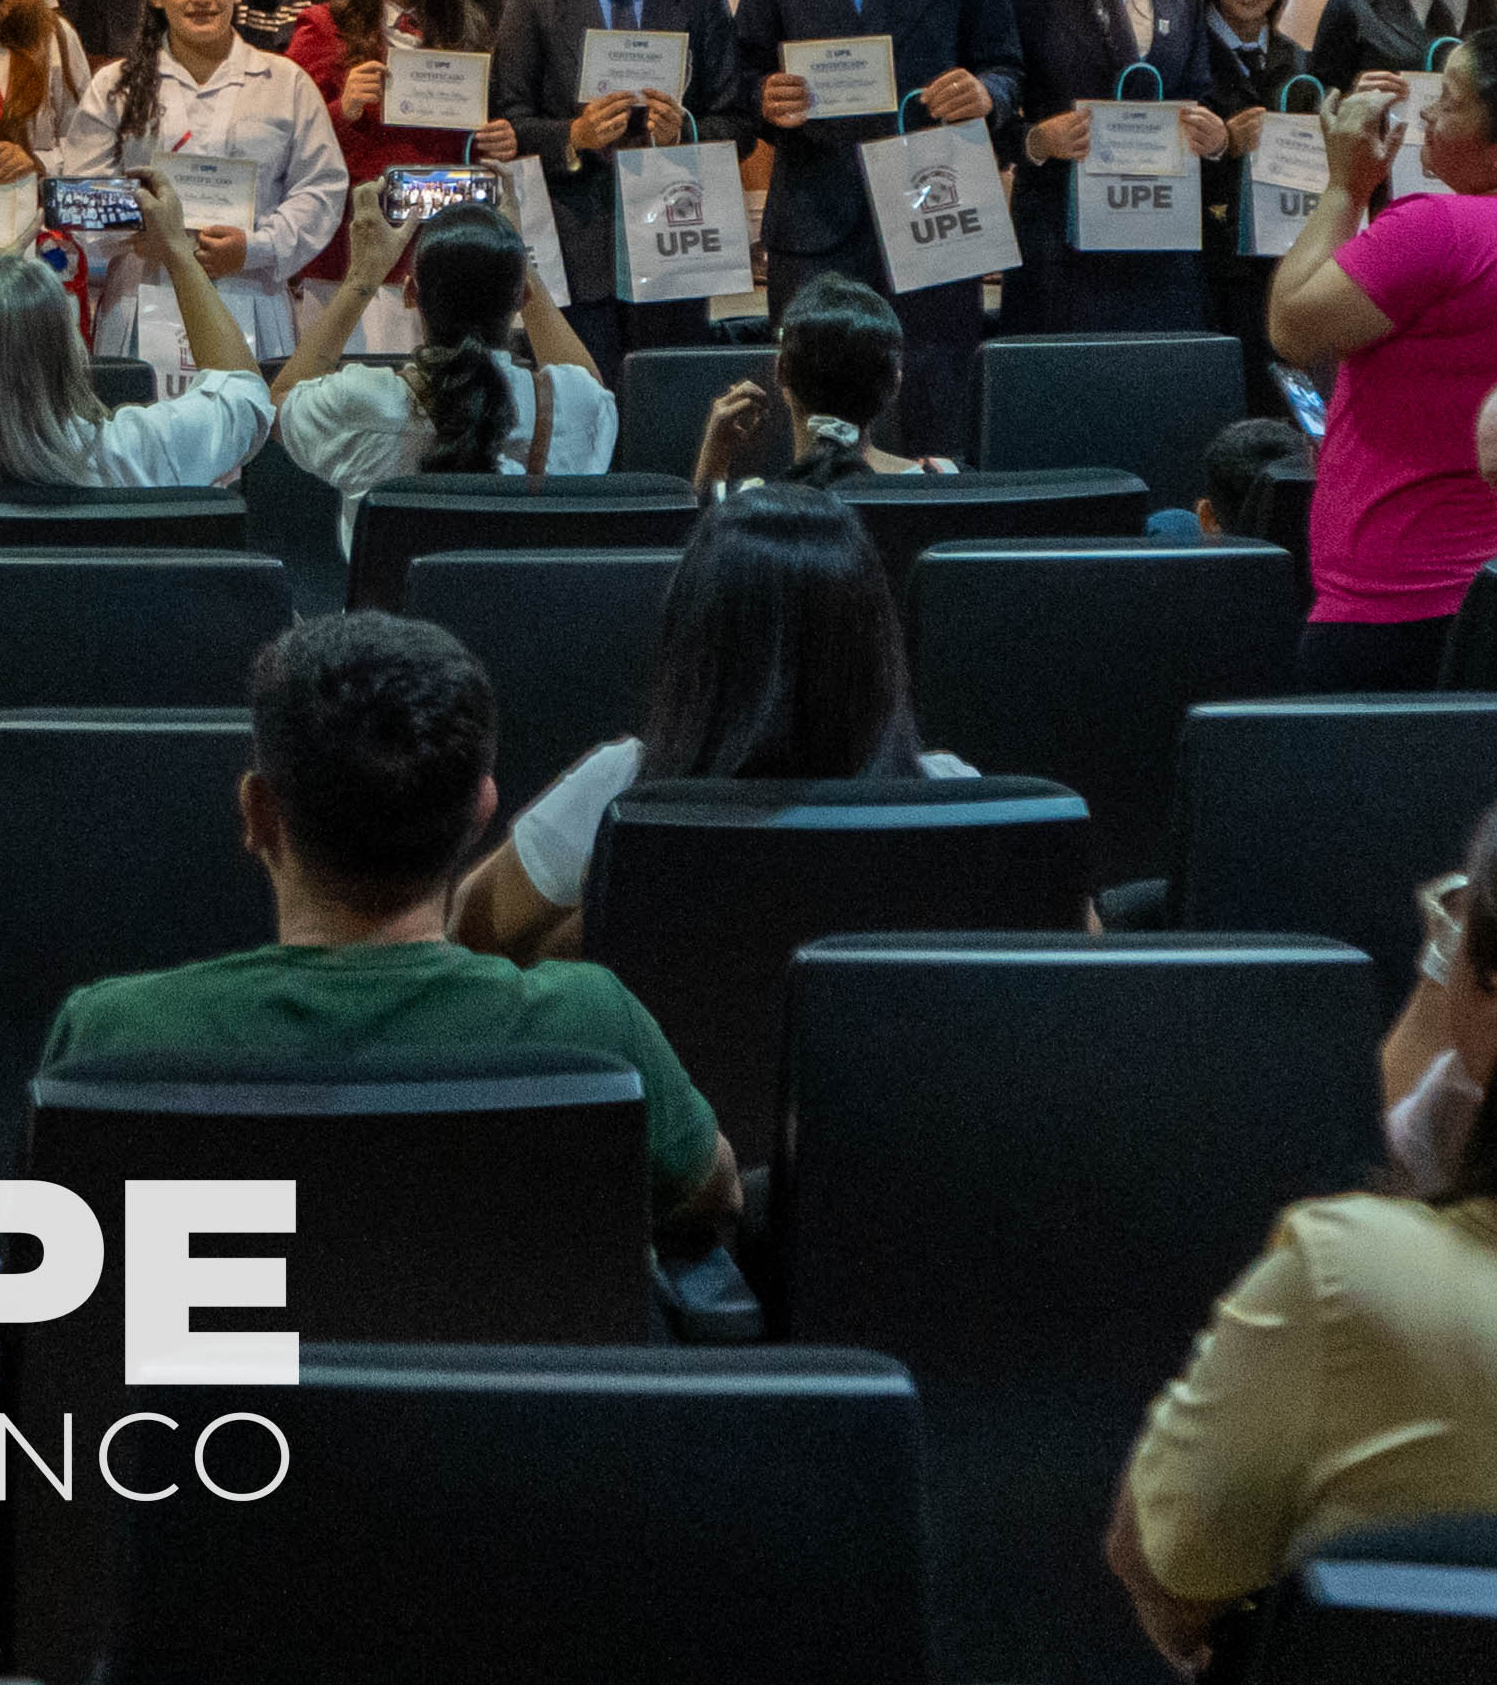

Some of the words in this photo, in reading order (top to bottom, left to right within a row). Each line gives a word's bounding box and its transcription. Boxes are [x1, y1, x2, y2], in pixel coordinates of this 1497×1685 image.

[1107, 186, 1172, 209] UPE
[1280, 193, 1320, 217] UP
[911, 209, 982, 245] UPE
[656, 228, 721, 256] UPE
